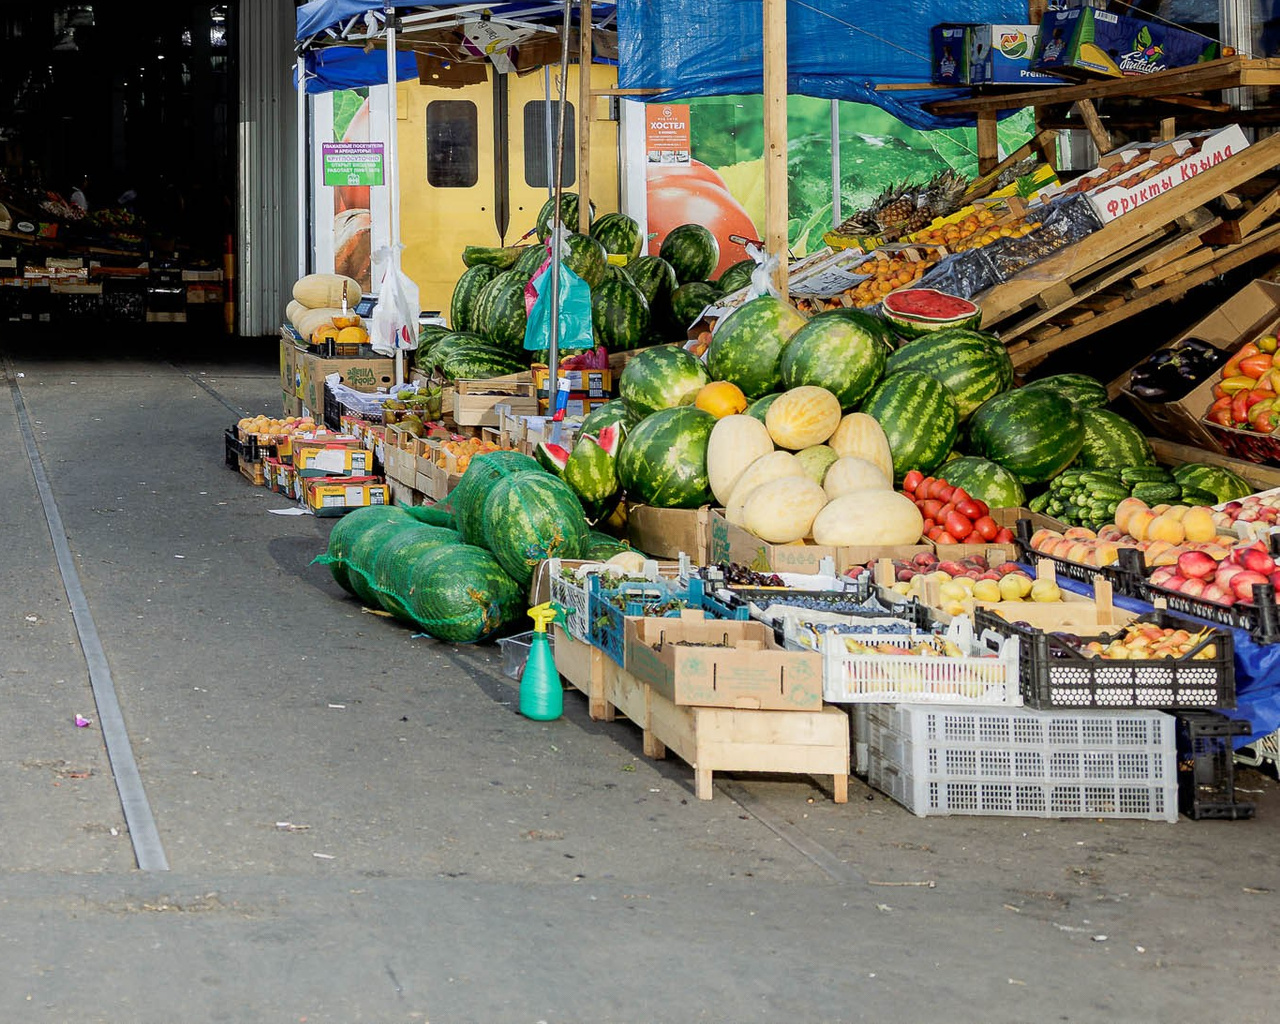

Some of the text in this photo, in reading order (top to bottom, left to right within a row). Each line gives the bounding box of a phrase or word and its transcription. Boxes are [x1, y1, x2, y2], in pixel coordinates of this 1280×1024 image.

[1106, 145, 1233, 216] Фрукты Крыма
[347, 367, 373, 376] Village
[350, 376, 376, 385] Global
